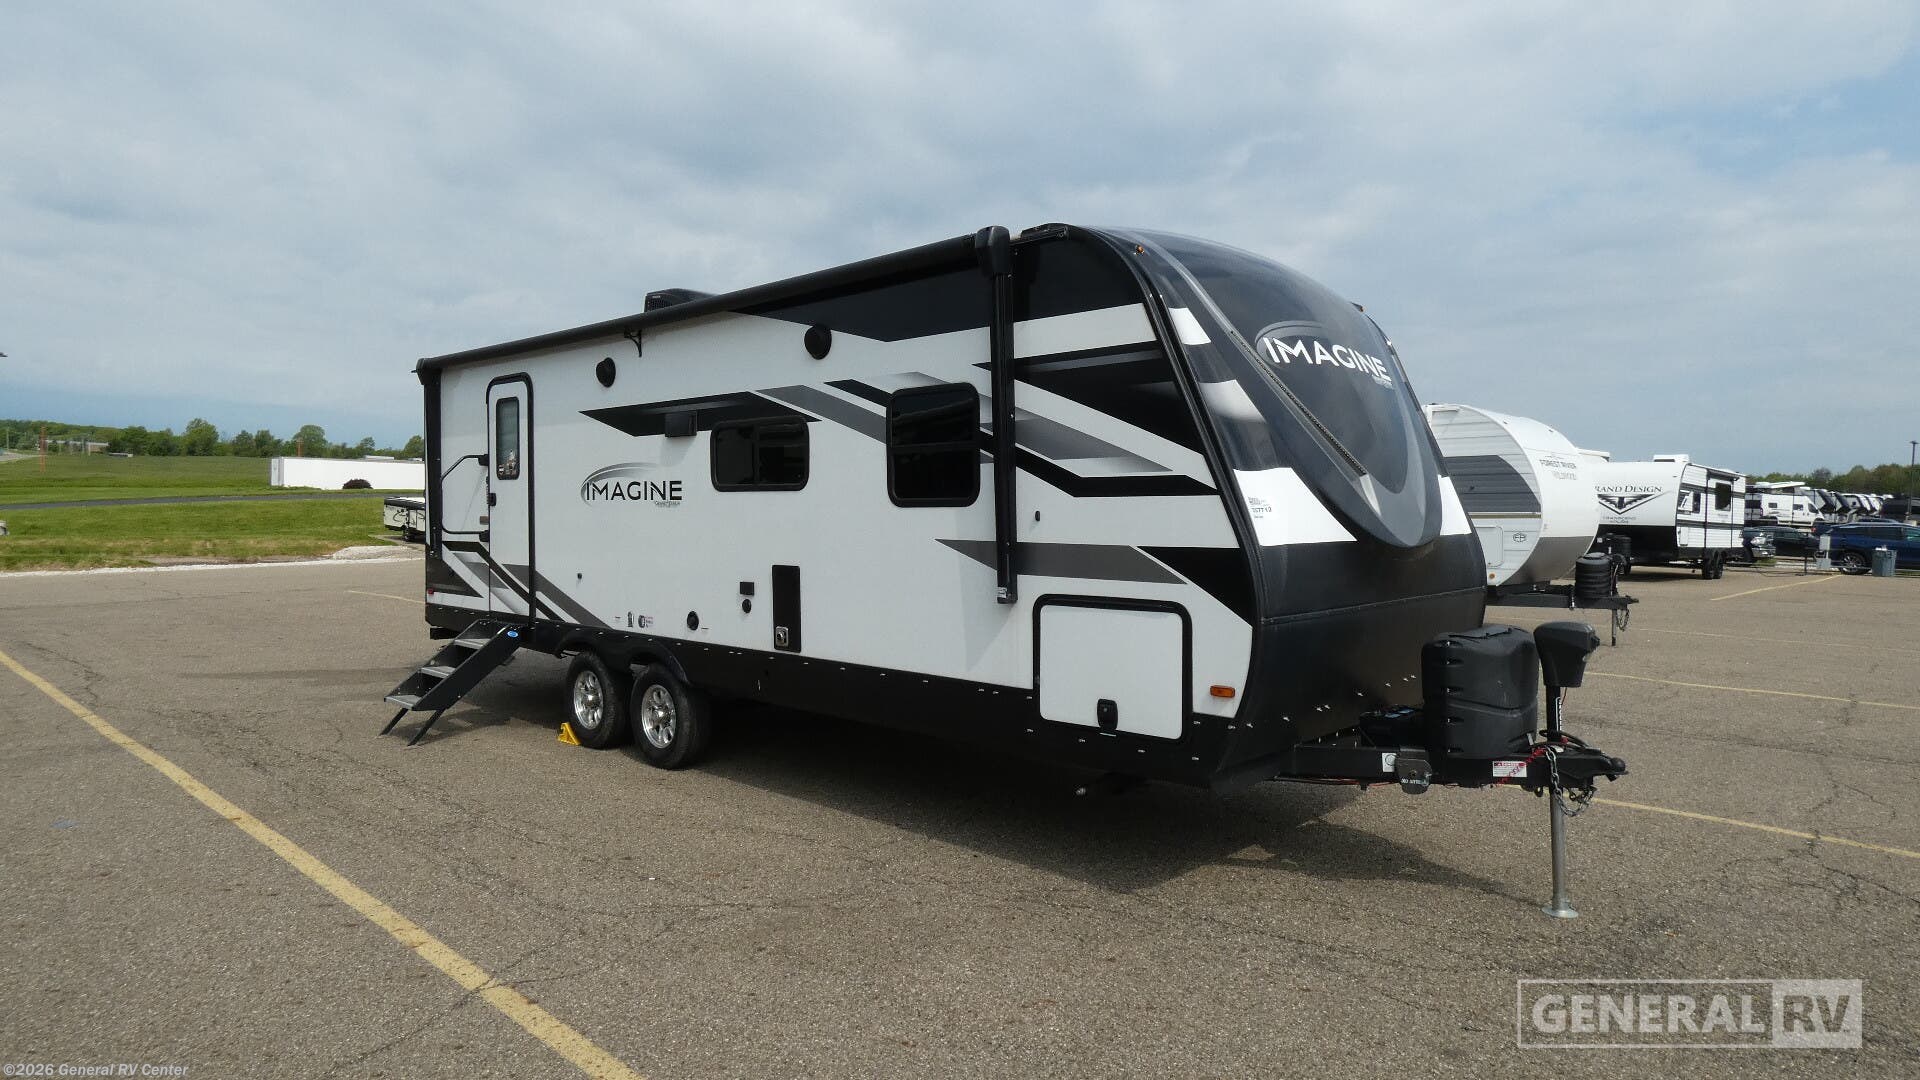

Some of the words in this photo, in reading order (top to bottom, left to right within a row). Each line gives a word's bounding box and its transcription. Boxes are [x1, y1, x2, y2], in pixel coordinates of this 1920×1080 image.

[1263, 337, 1392, 382] IMAGINE
[1539, 459, 1560, 468] FOREST
[1560, 461, 1577, 469] RIVER
[586, 480, 682, 501] IMAGINE
